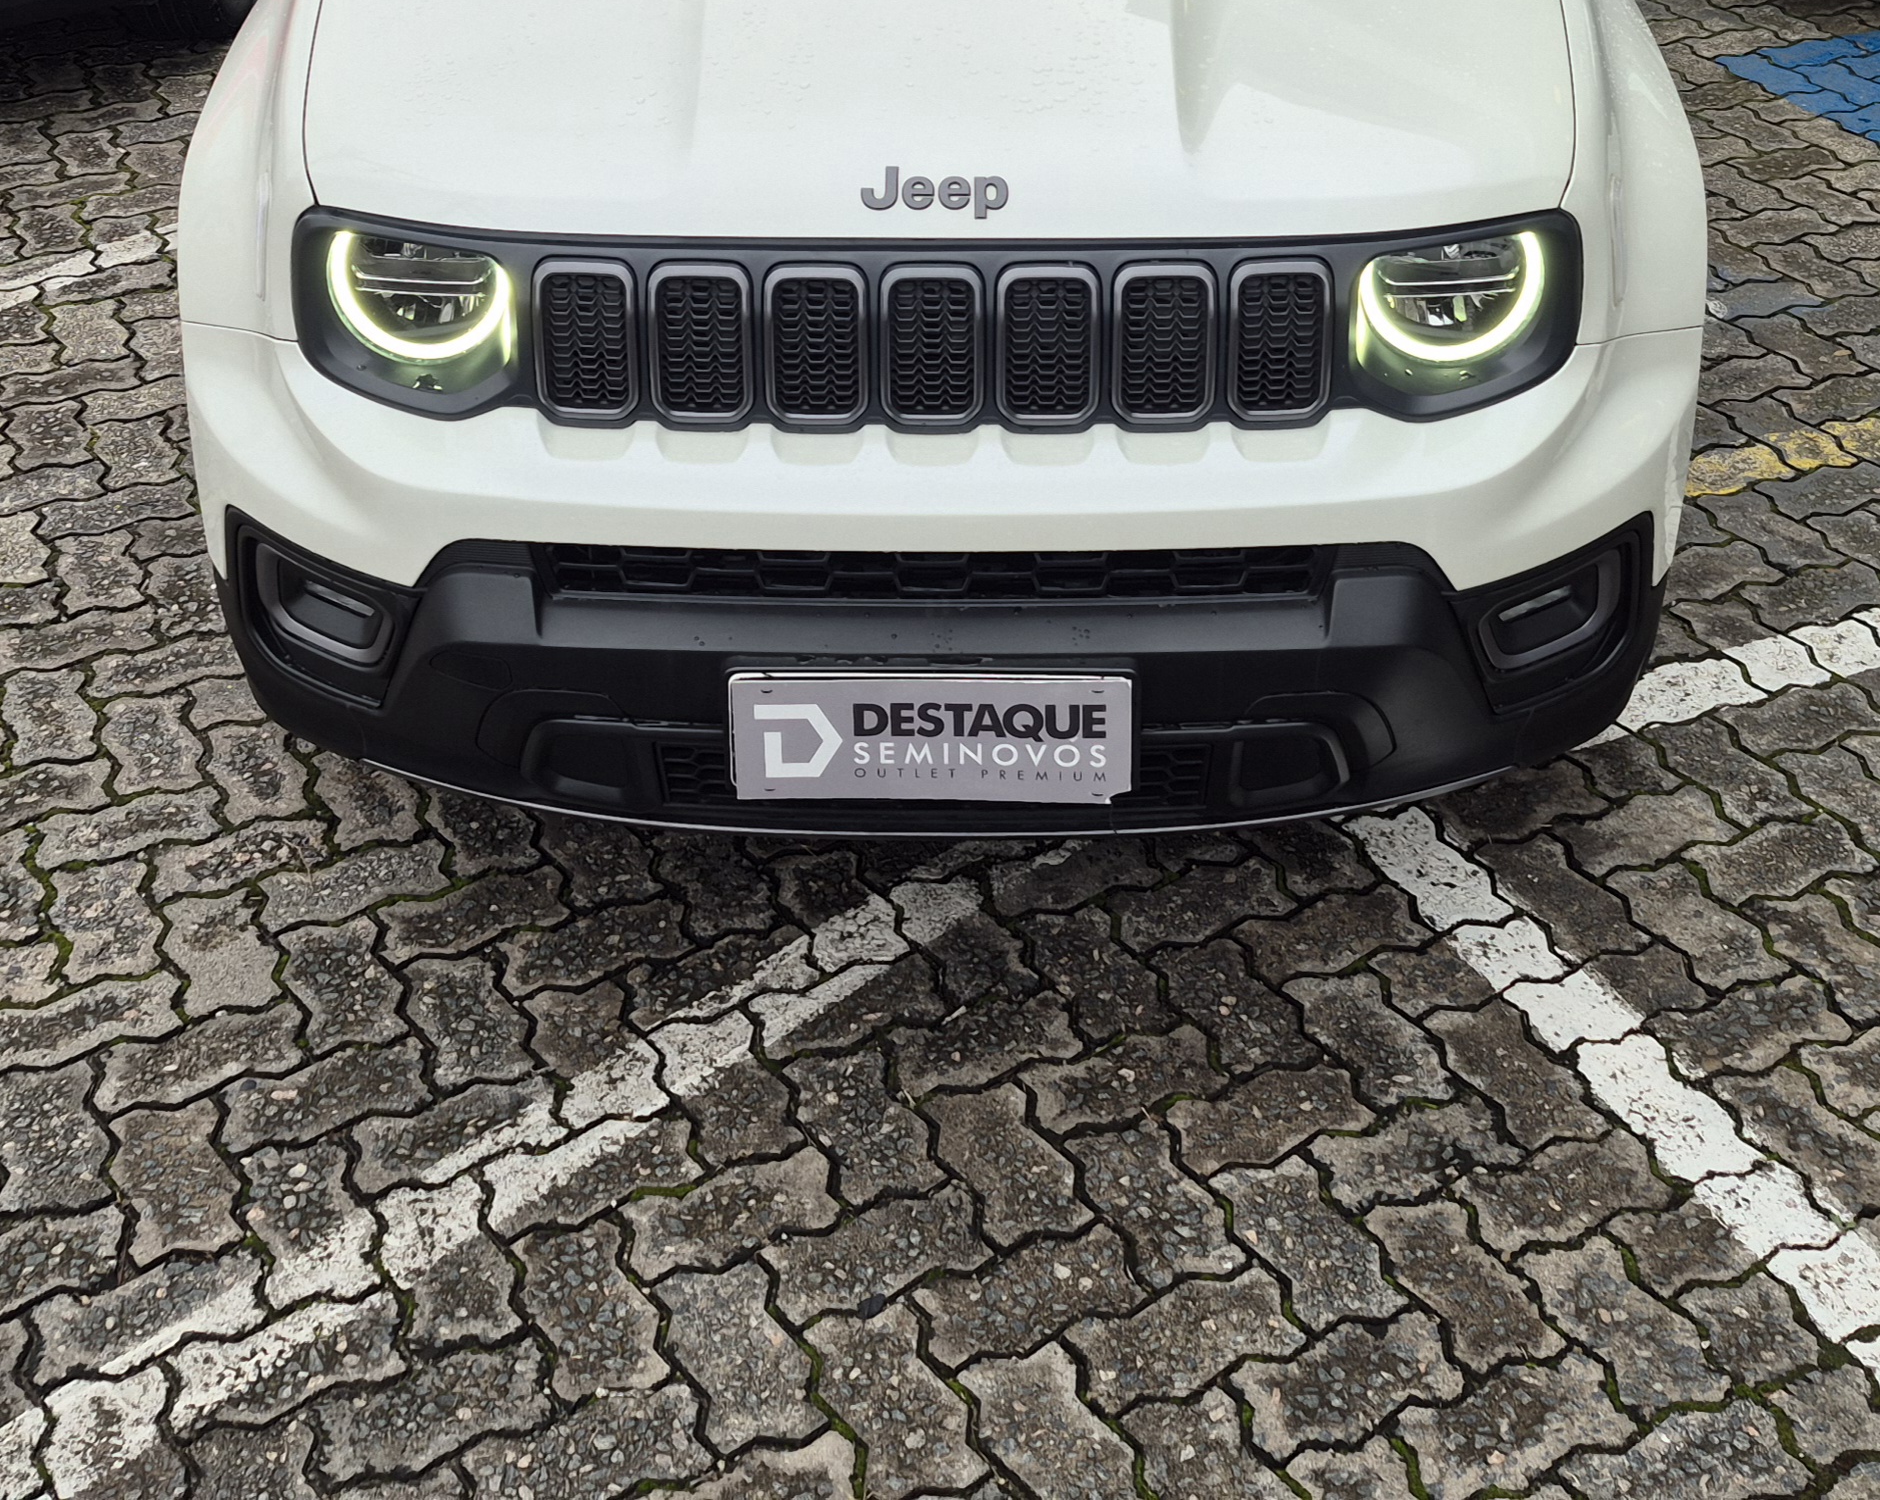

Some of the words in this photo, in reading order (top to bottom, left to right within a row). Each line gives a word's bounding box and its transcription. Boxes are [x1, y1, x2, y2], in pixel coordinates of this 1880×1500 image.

[860, 166, 1009, 219] Jeep
[853, 702, 1107, 742] DESTAQUE
[853, 741, 1108, 768] SEMINOVOS
[853, 767, 957, 779] OUTLET
[981, 768, 1108, 782] PREMIUM
